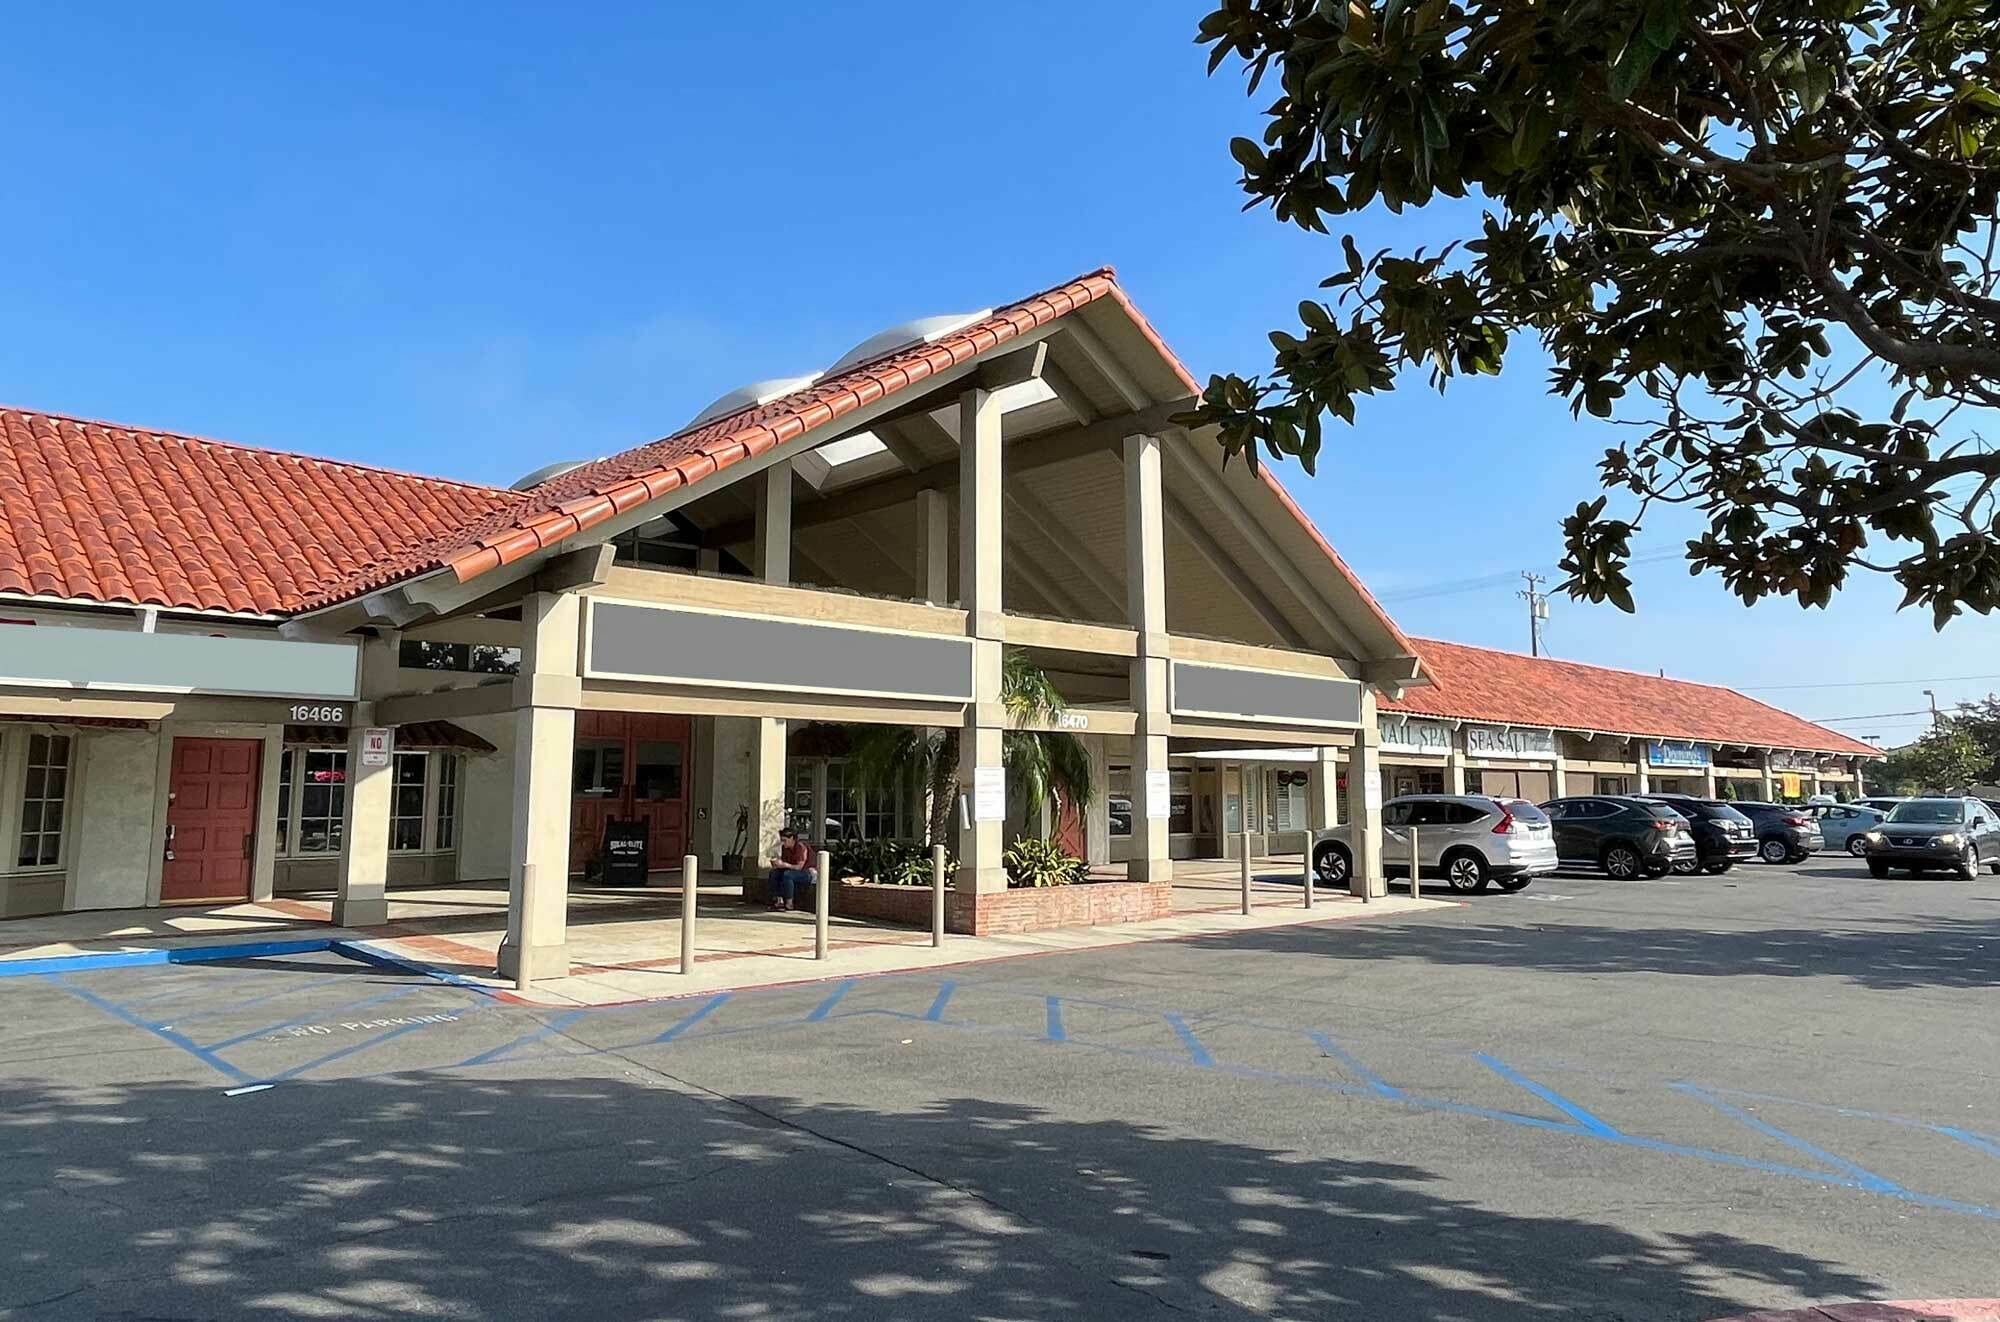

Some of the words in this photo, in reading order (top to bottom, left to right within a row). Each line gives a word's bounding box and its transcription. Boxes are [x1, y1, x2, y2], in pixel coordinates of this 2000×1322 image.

[290, 705, 343, 722] 16466
[371, 737, 382, 749] NO
[1380, 723, 1413, 745] NAIL
[1420, 726, 1448, 747] SPA
[1469, 730, 1494, 750] SEA
[1498, 732, 1529, 752] SALT
[289, 1025, 332, 1037] NO
[340, 1013, 459, 1031] PARKING
